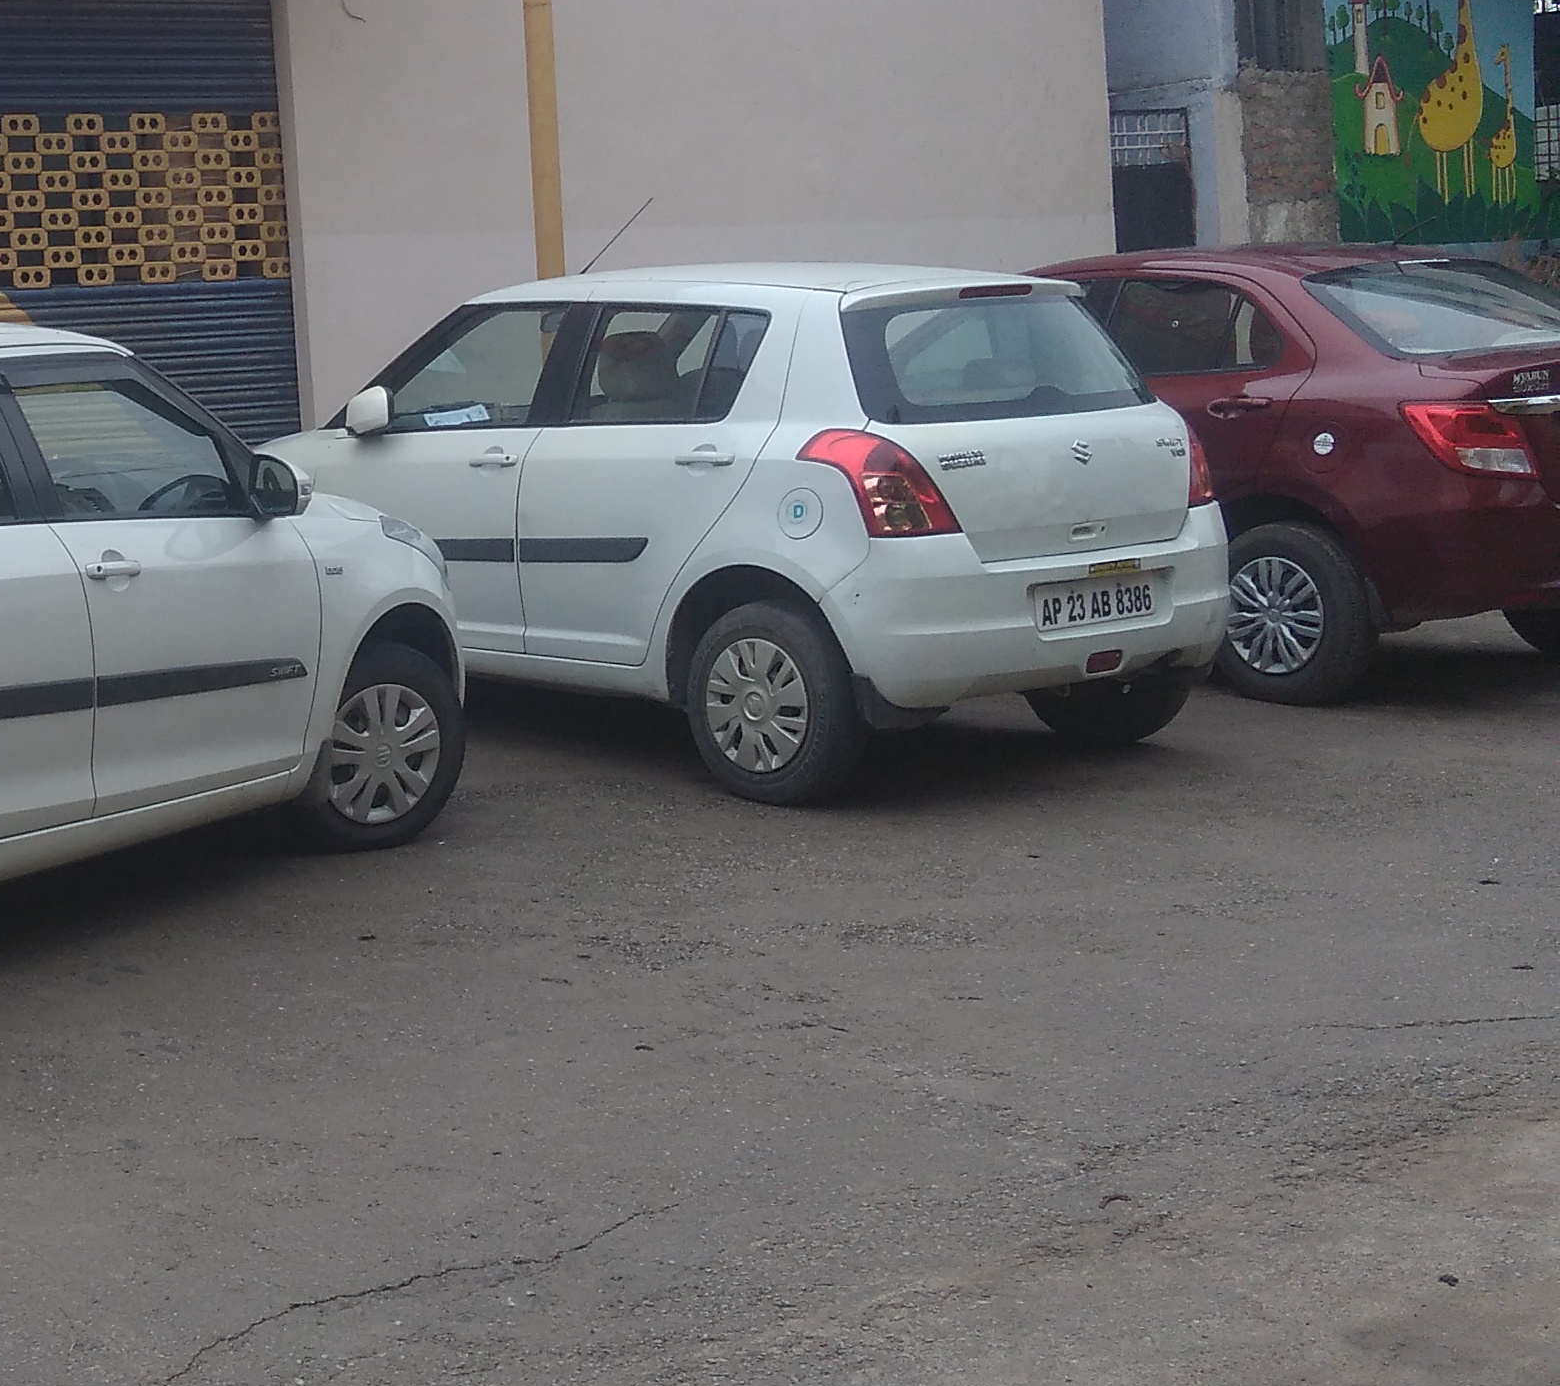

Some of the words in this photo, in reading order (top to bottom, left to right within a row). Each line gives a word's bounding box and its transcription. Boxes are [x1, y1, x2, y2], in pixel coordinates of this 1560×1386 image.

[1042, 597, 1062, 626] AP
[1066, 593, 1086, 623] 23
[1090, 590, 1112, 619] AB
[1115, 584, 1152, 616] 8386
